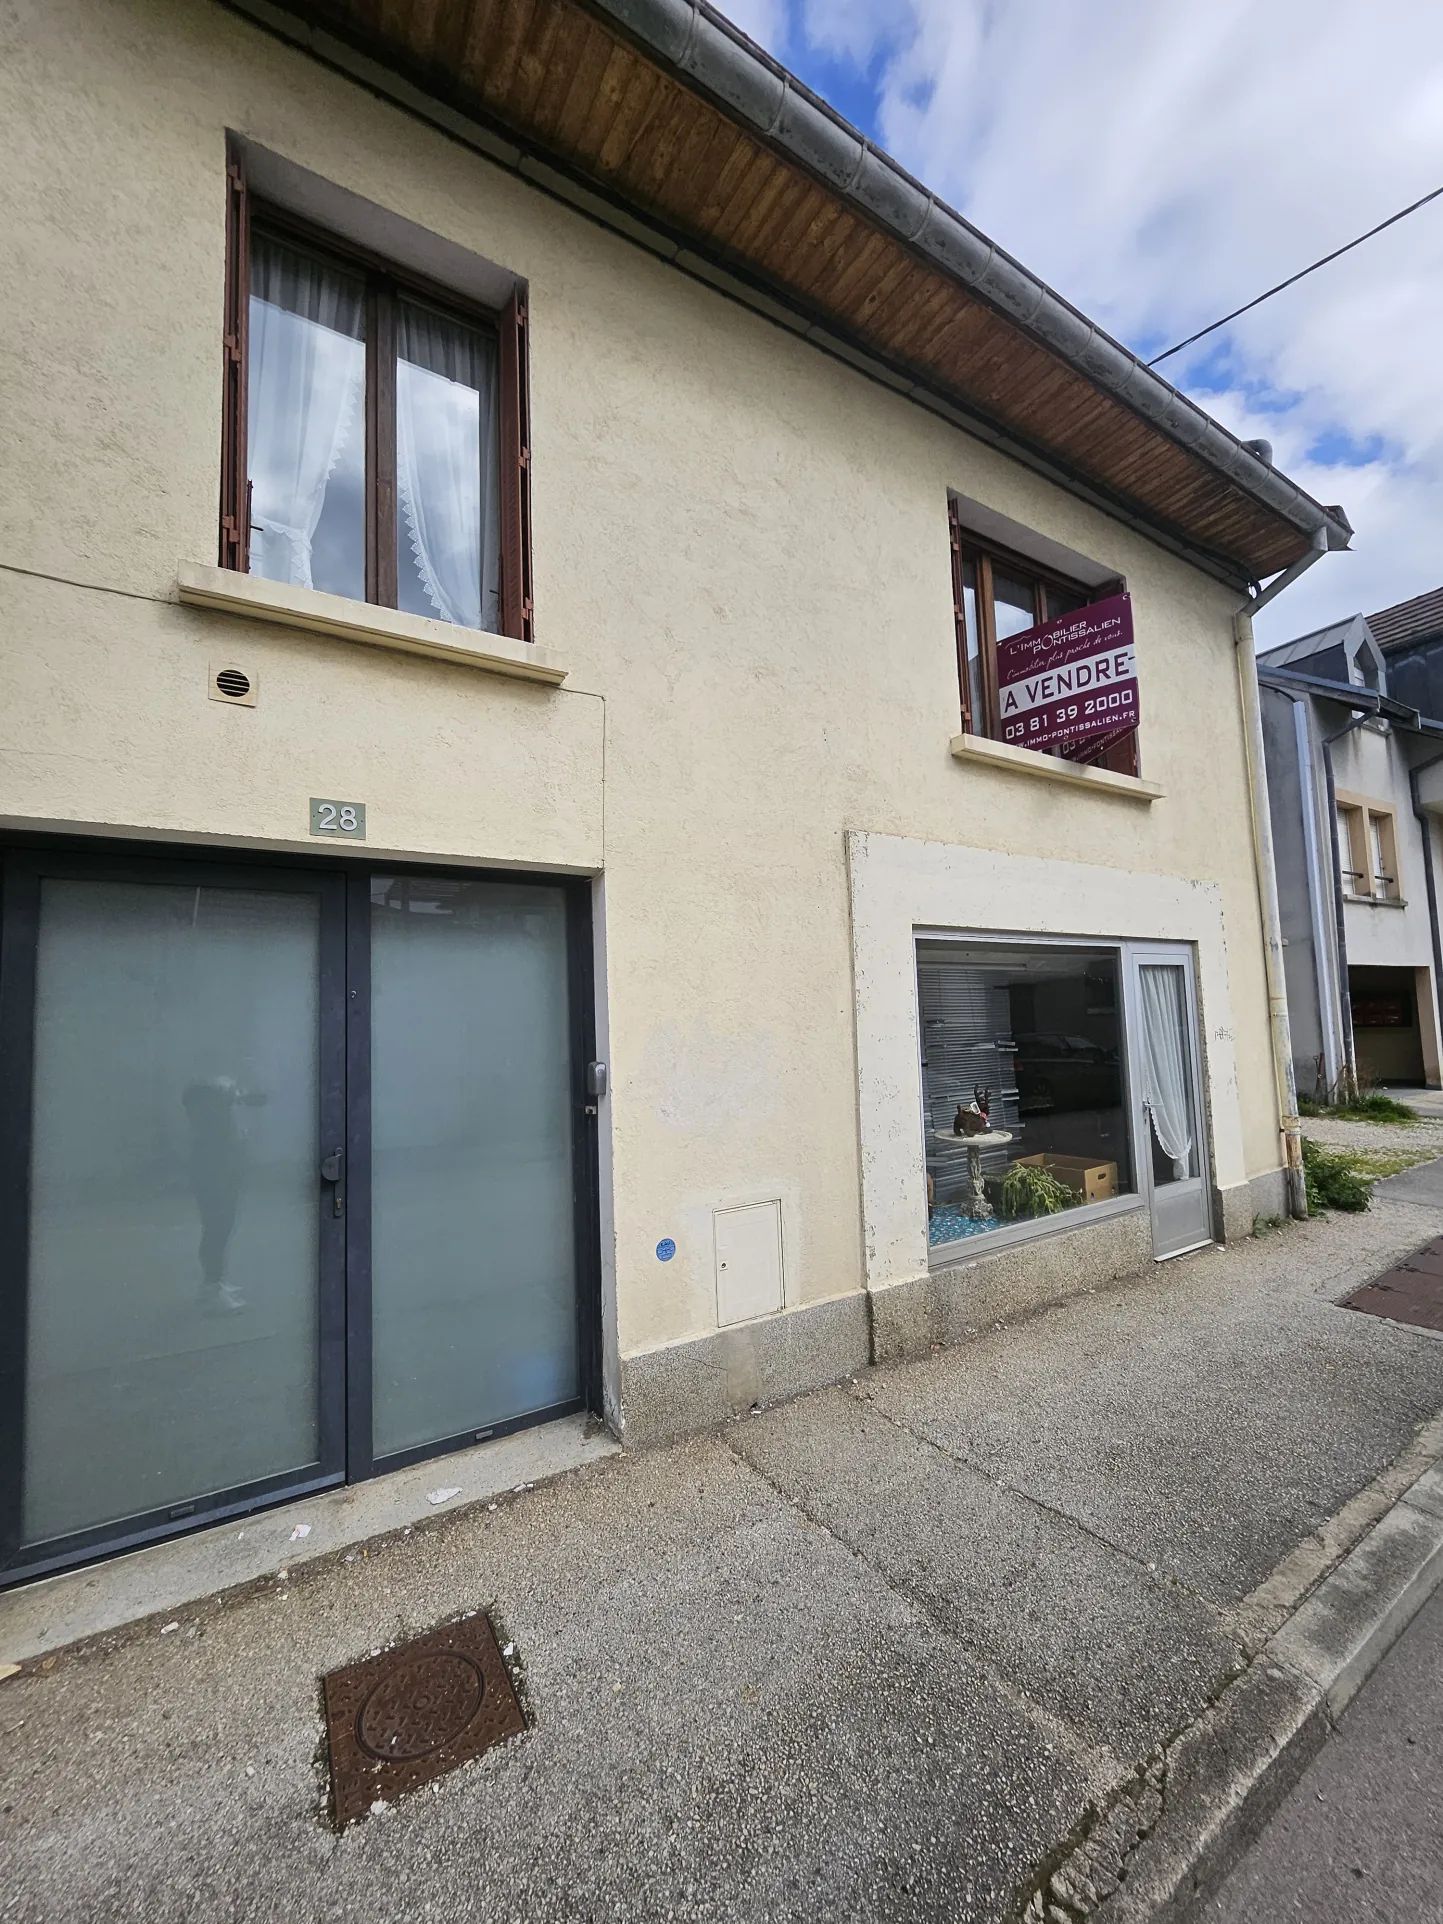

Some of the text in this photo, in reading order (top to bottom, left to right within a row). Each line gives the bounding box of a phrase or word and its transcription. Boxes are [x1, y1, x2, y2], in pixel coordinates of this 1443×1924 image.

[1010, 621, 1087, 655] L'IMMOBILIER
[1033, 617, 1121, 655] PONTISSALIEN
[1046, 650, 1063, 670] plus
[1065, 639, 1091, 663] proche
[1093, 635, 1101, 646] de
[1004, 652, 1130, 713] A VENDRE
[1005, 689, 1133, 739] 03 81 39 2000
[318, 803, 358, 831] 28
